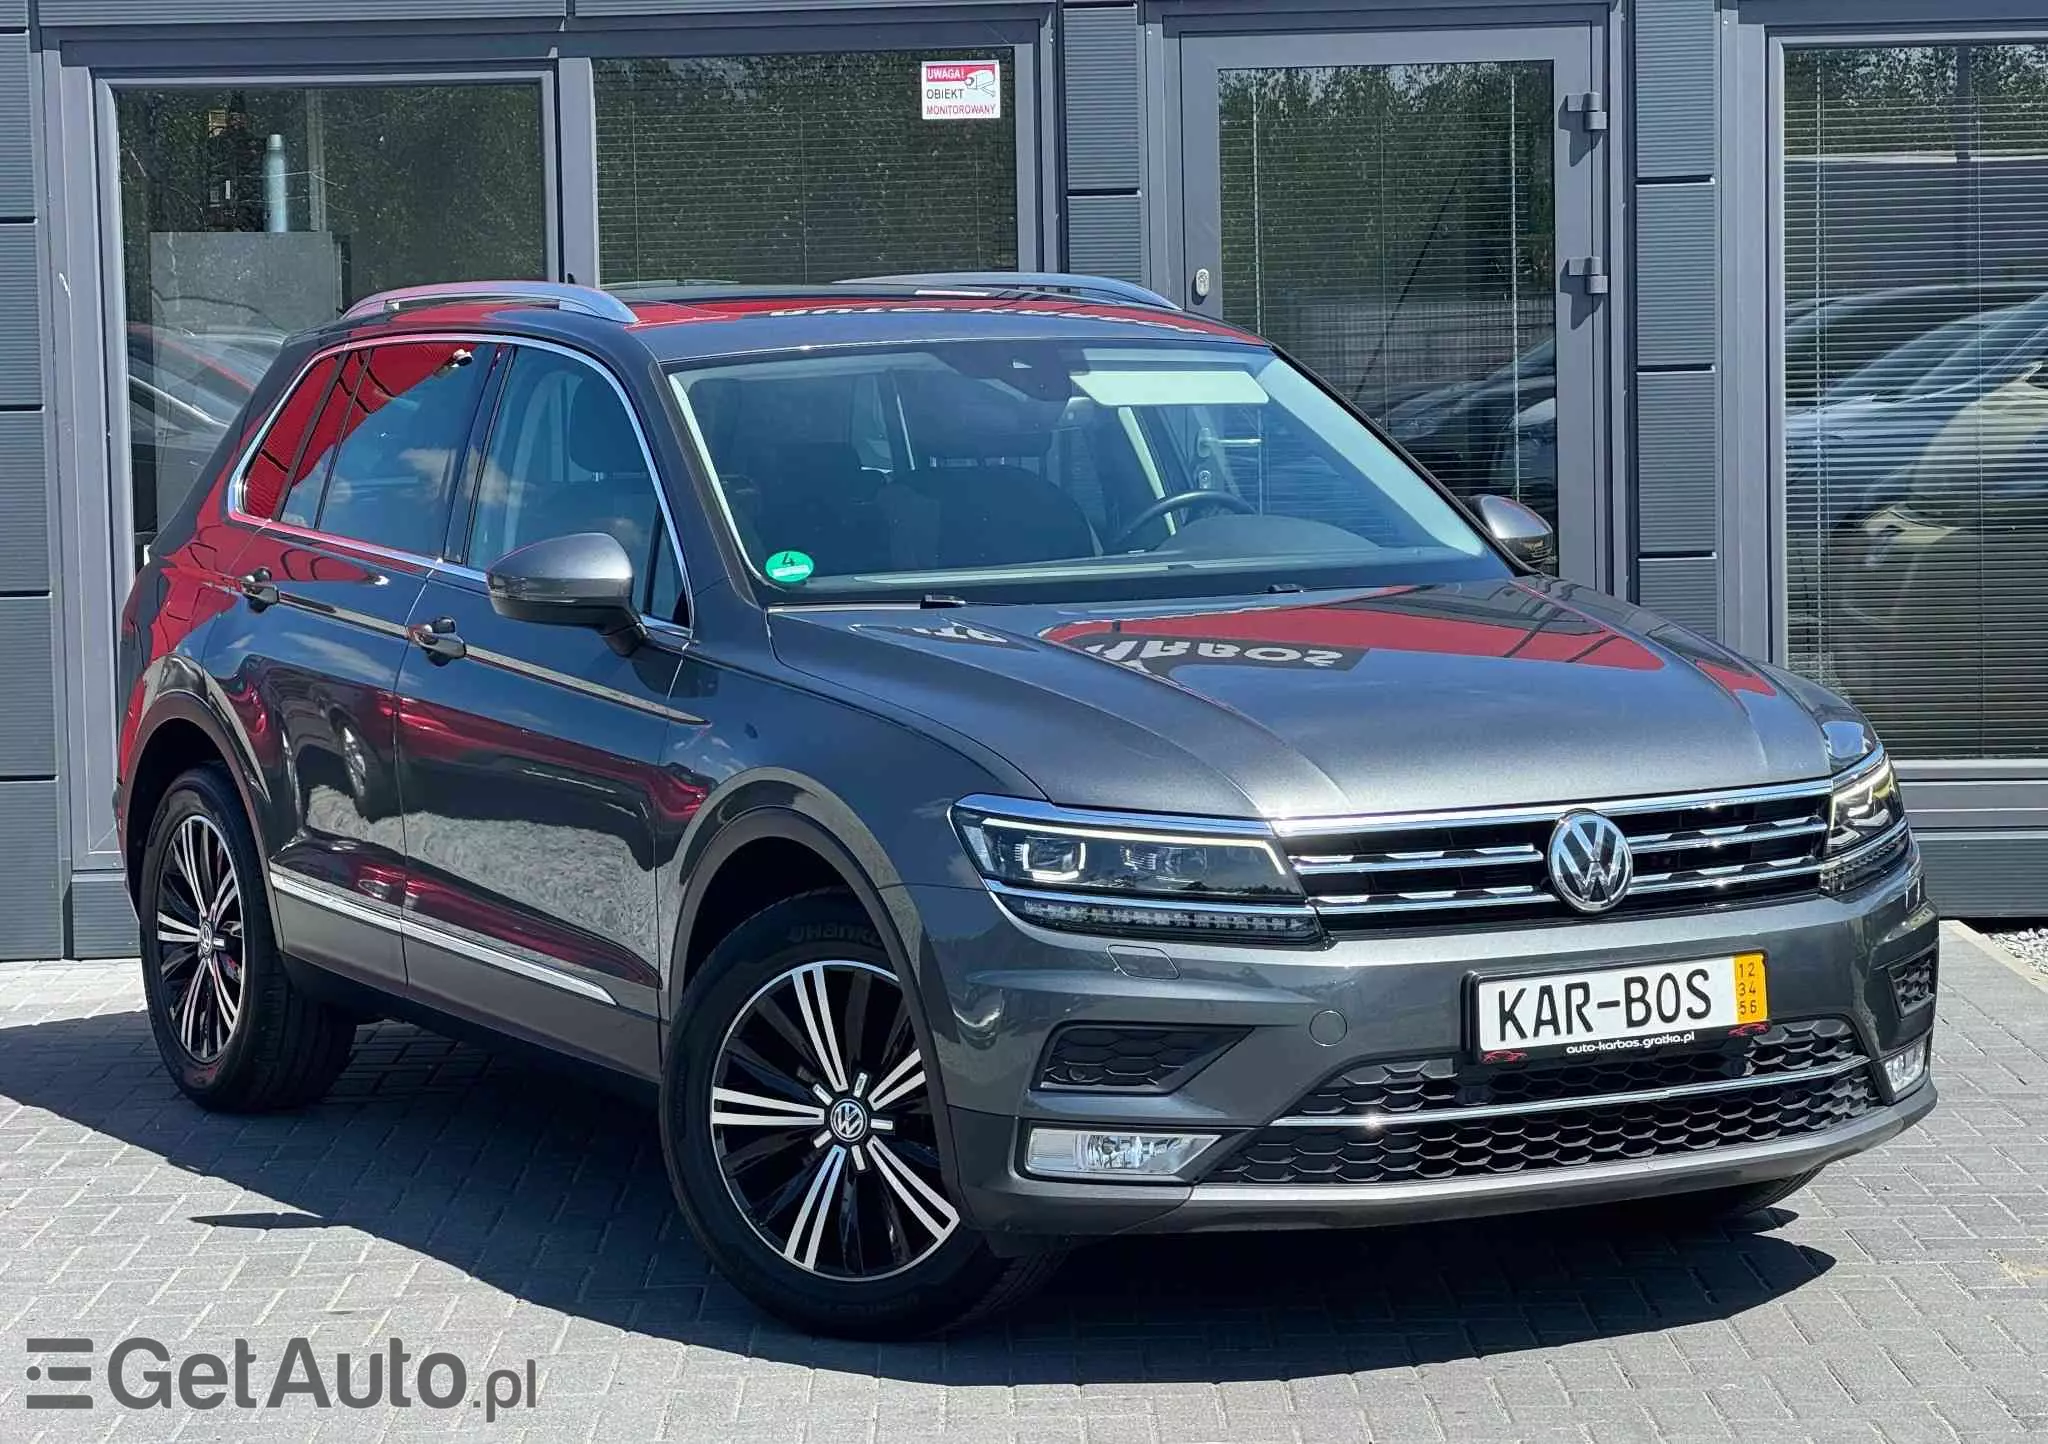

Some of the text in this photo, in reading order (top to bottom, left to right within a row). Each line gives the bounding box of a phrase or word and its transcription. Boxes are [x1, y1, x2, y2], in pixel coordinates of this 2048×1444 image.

[926, 88, 964, 99] OBIEKT
[926, 104, 996, 115] MONITOROWANY
[782, 552, 795, 567] 4
[1550, 810, 1631, 909] VW
[1739, 962, 1755, 978] 12
[1739, 980, 1756, 996] 34
[1498, 968, 1712, 1042] KAR-BOS
[1740, 1000, 1757, 1015] 56
[1566, 1031, 1695, 1054] auto-karbos.gratka.pl
[832, 1100, 867, 1141] VW
